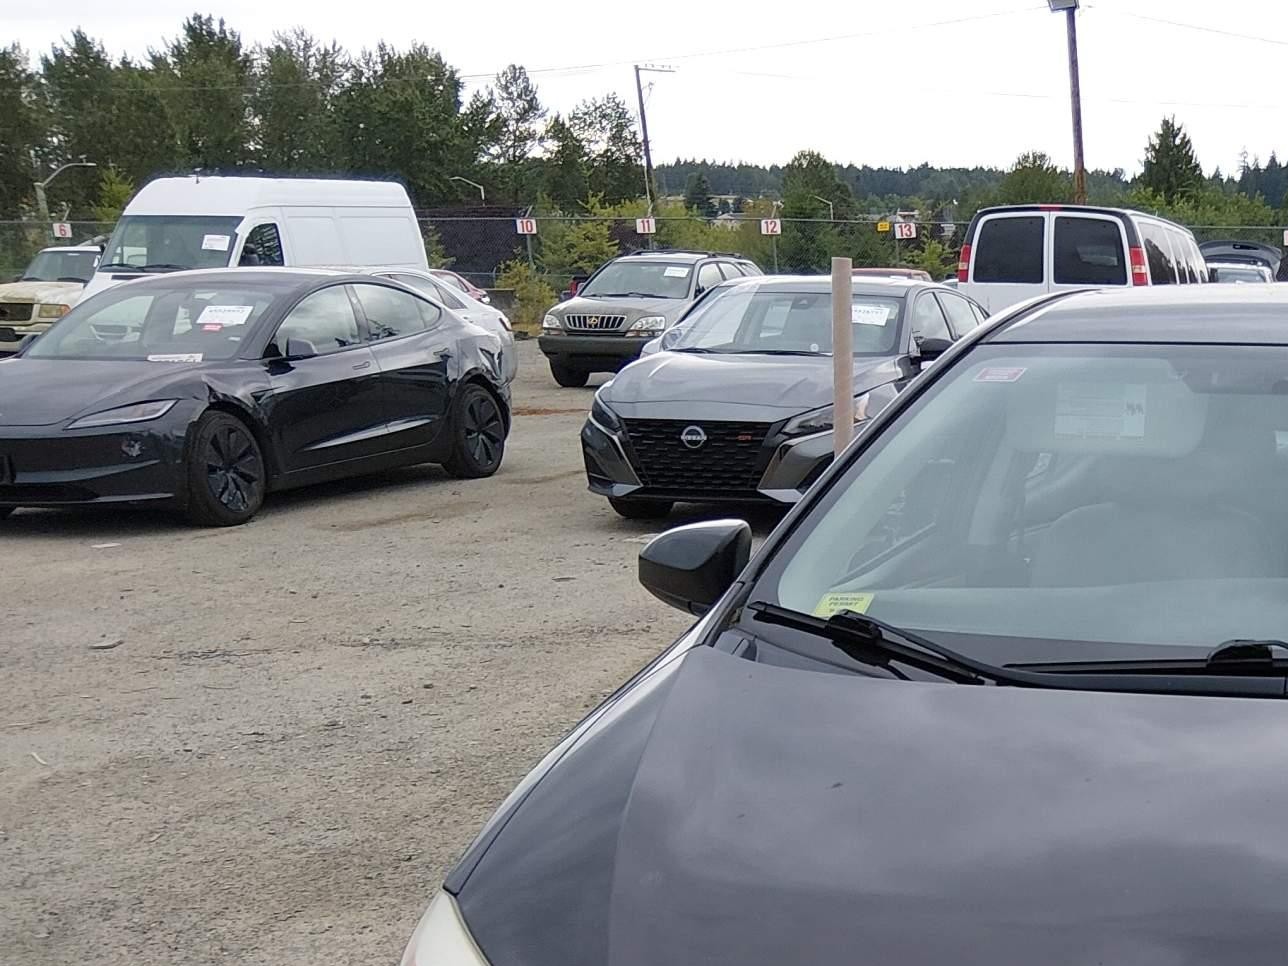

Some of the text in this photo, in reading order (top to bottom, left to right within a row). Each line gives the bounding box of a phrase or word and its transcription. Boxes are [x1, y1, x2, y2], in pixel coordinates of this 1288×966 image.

[59, 224, 68, 237] 6
[520, 220, 534, 233] 10
[640, 220, 652, 233] 11
[764, 220, 778, 233] 12
[898, 224, 912, 237] 13
